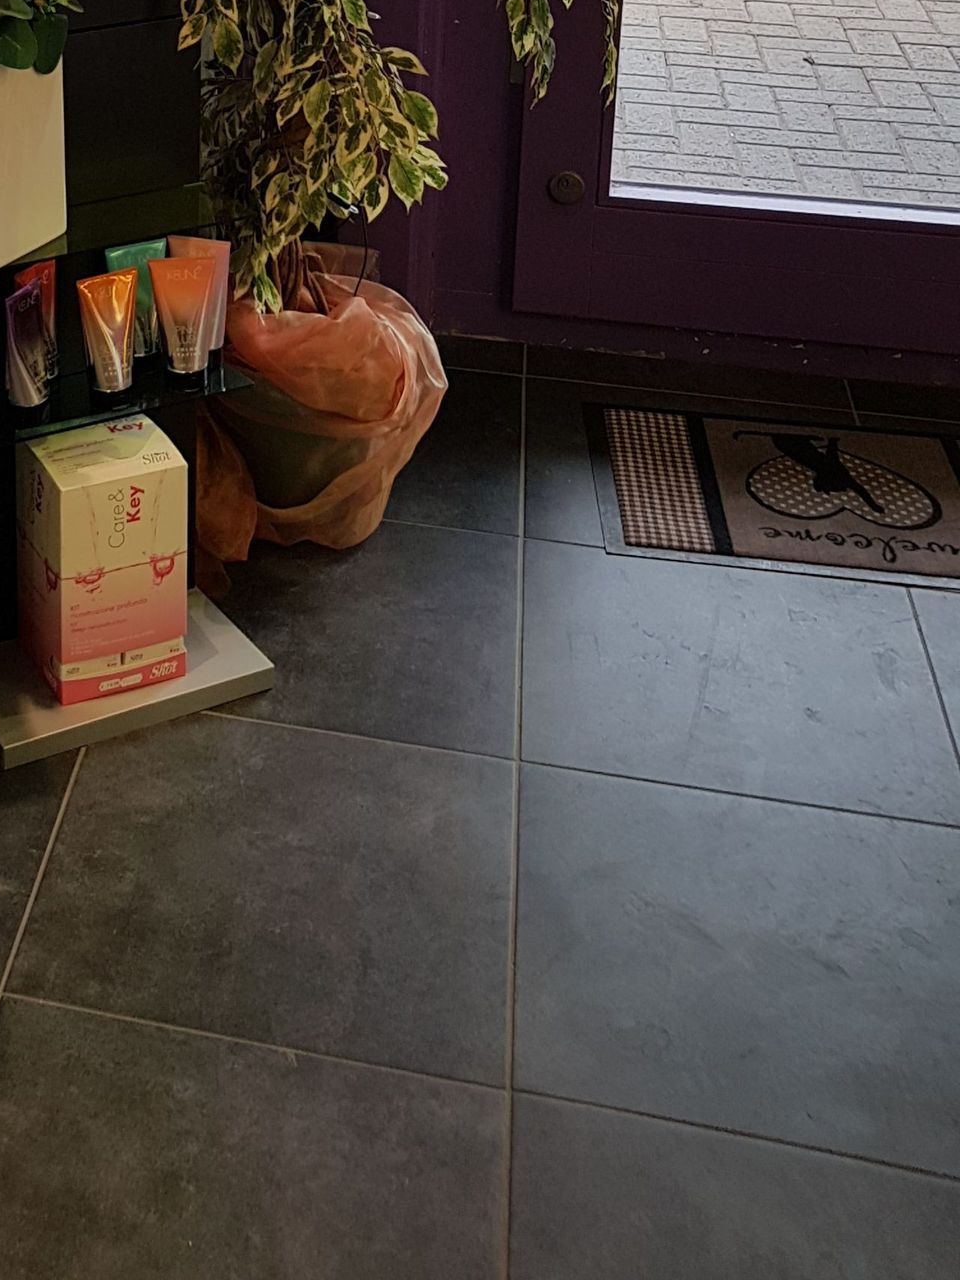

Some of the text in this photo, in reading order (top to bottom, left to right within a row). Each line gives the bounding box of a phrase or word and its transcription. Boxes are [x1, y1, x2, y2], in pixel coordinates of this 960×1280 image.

[106, 421, 144, 434] Key
[142, 451, 172, 466] Shot
[126, 485, 145, 524] Key
[758, 526, 960, 563] welcome
[149, 661, 179, 680] Shot
